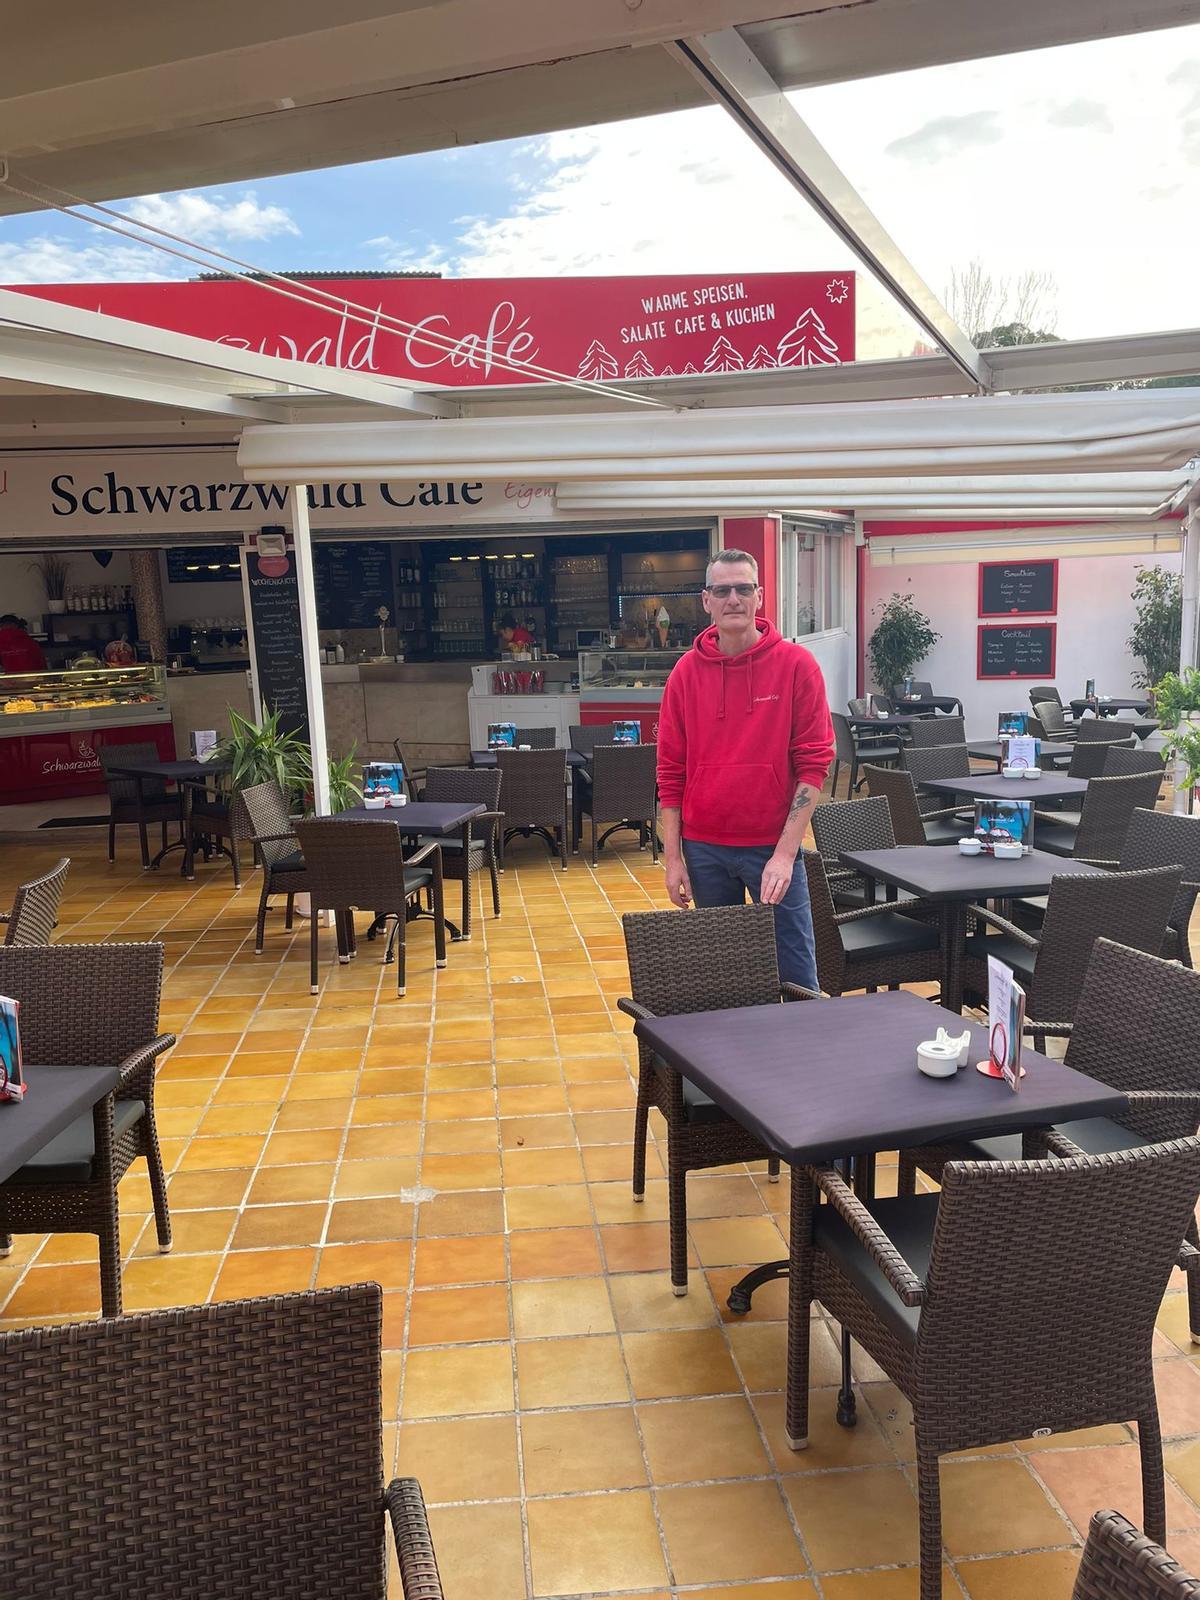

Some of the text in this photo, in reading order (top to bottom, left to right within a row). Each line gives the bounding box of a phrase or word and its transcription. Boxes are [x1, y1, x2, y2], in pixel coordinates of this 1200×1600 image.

[641, 291, 689, 314] WARME
[620, 303, 775, 344] SALATE CAFE & KUCHEN
[404, 301, 540, 379] Café
[42, 756, 102, 774] Schwarzwal
